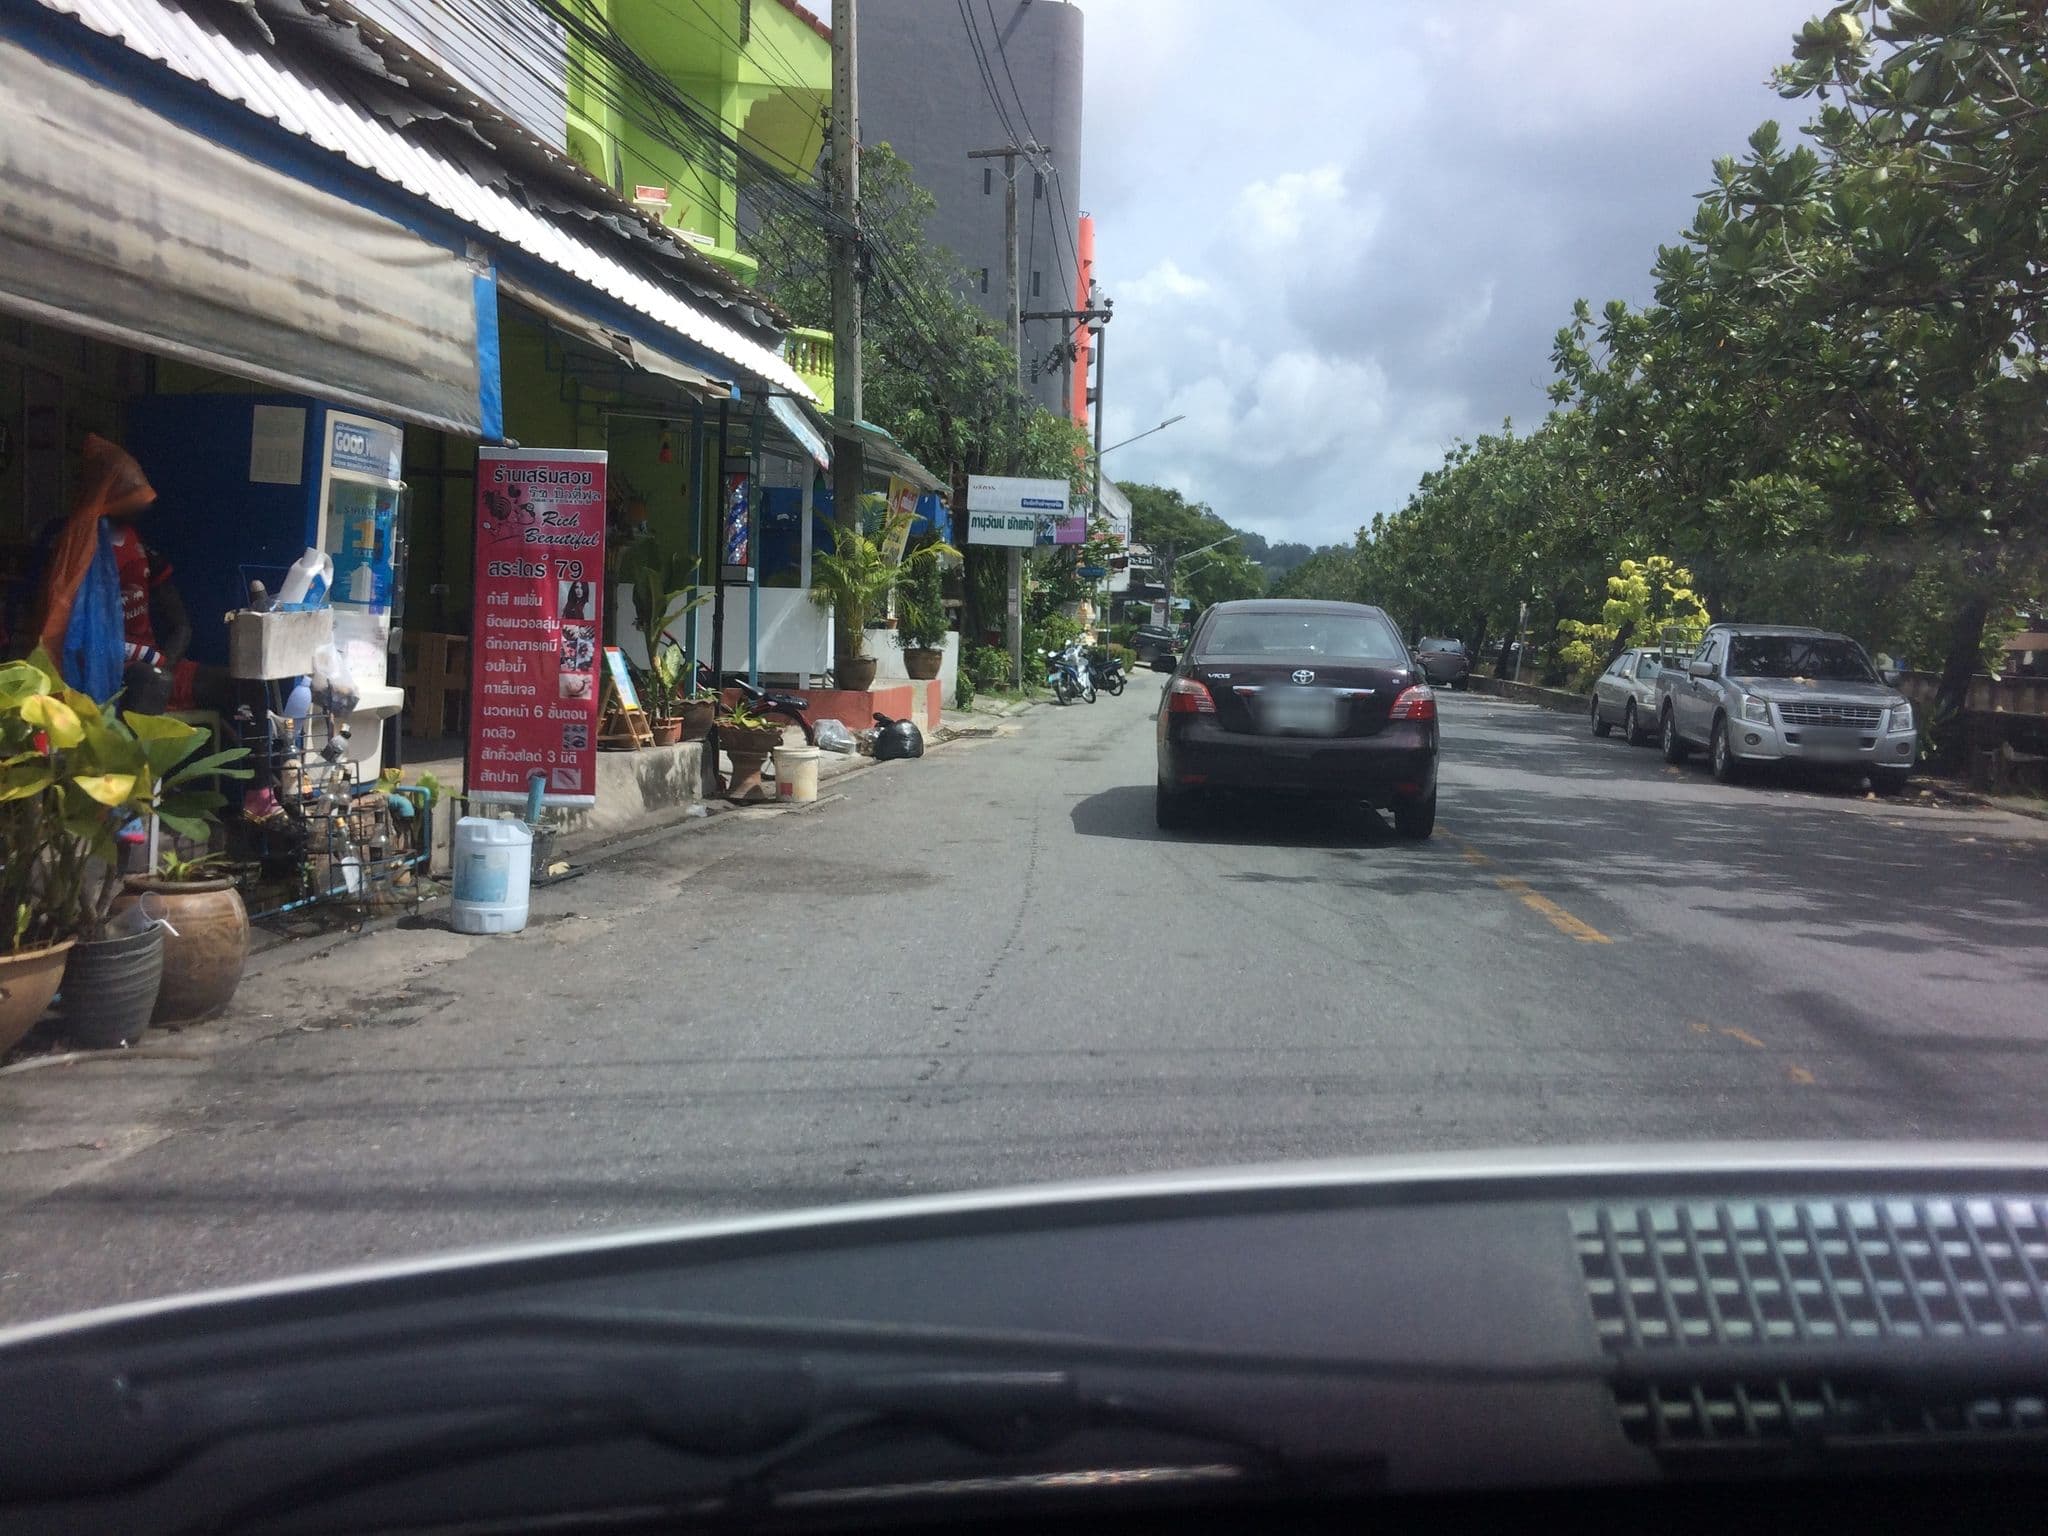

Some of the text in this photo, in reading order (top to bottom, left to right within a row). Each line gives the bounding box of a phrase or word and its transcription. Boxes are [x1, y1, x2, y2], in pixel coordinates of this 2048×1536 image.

[494, 464, 592, 485] ร้านเสริมสวย
[541, 510, 580, 528] Rich
[525, 528, 600, 549] Beautiful
[555, 560, 583, 580] 79
[486, 589, 543, 606] ทำสี แฟชั่น
[485, 656, 526, 672] อบไอน้ำ
[483, 702, 588, 721] นวดหน้า 6 ขั้นตอน
[482, 726, 516, 741] กดสิว
[547, 749, 556, 764] 3
[560, 750, 577, 765] มิติ
[480, 768, 519, 784] สักปาก
